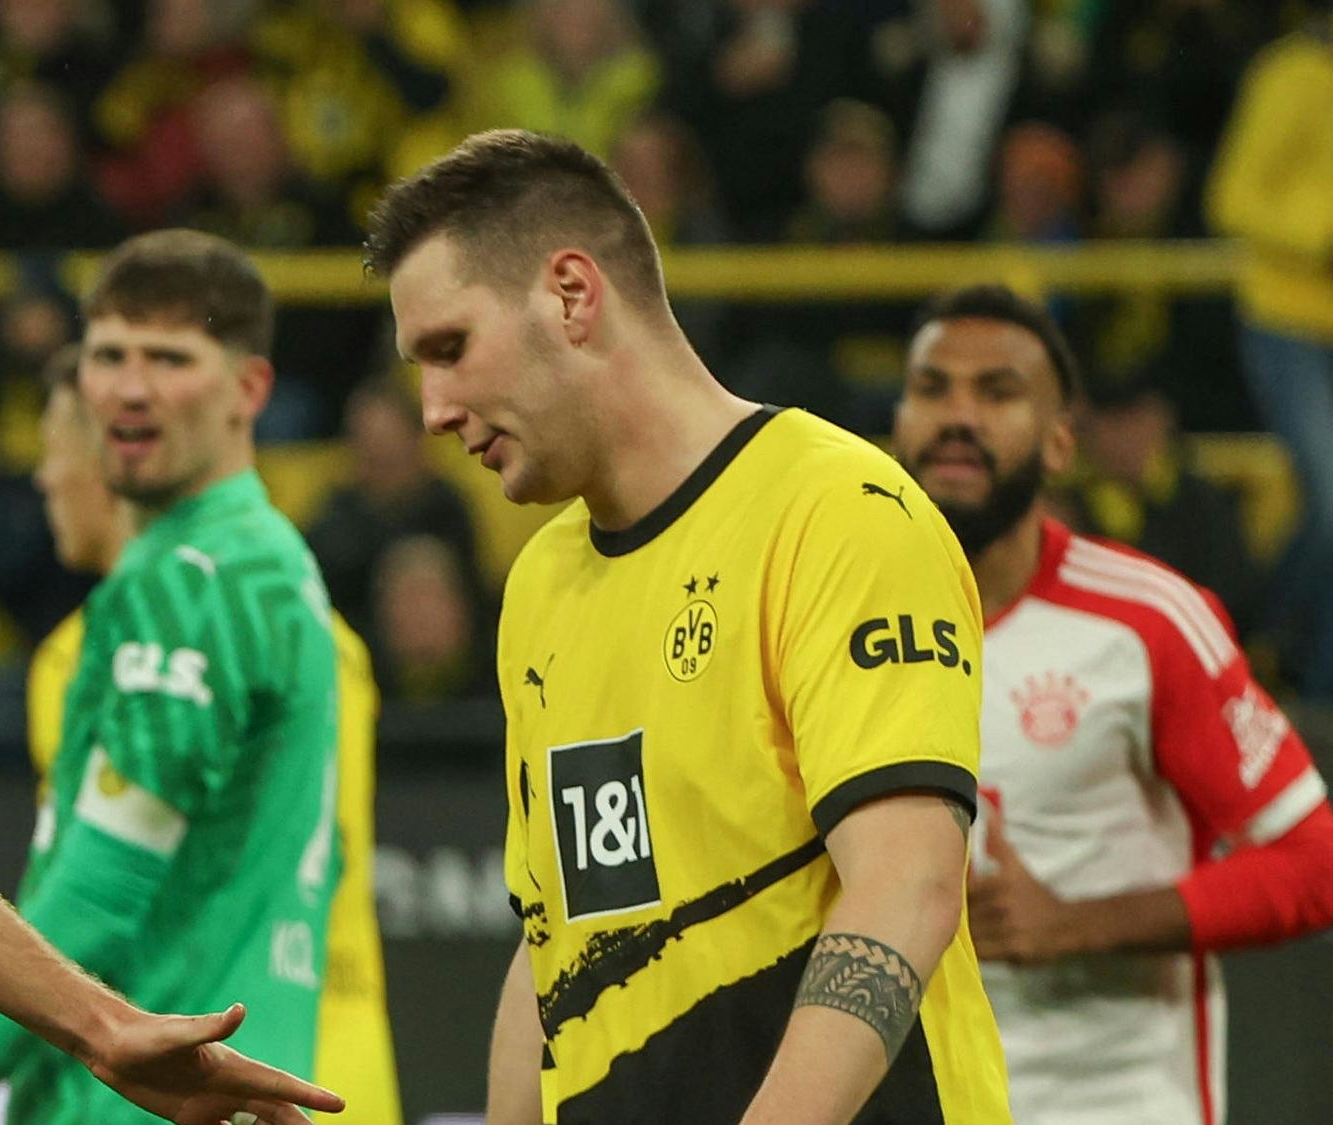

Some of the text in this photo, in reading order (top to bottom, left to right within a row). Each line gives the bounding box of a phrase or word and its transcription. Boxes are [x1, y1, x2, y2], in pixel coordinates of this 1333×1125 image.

[672, 607, 713, 659] BVB
[681, 657, 697, 675] 09
[561, 775, 651, 871] 1&1
